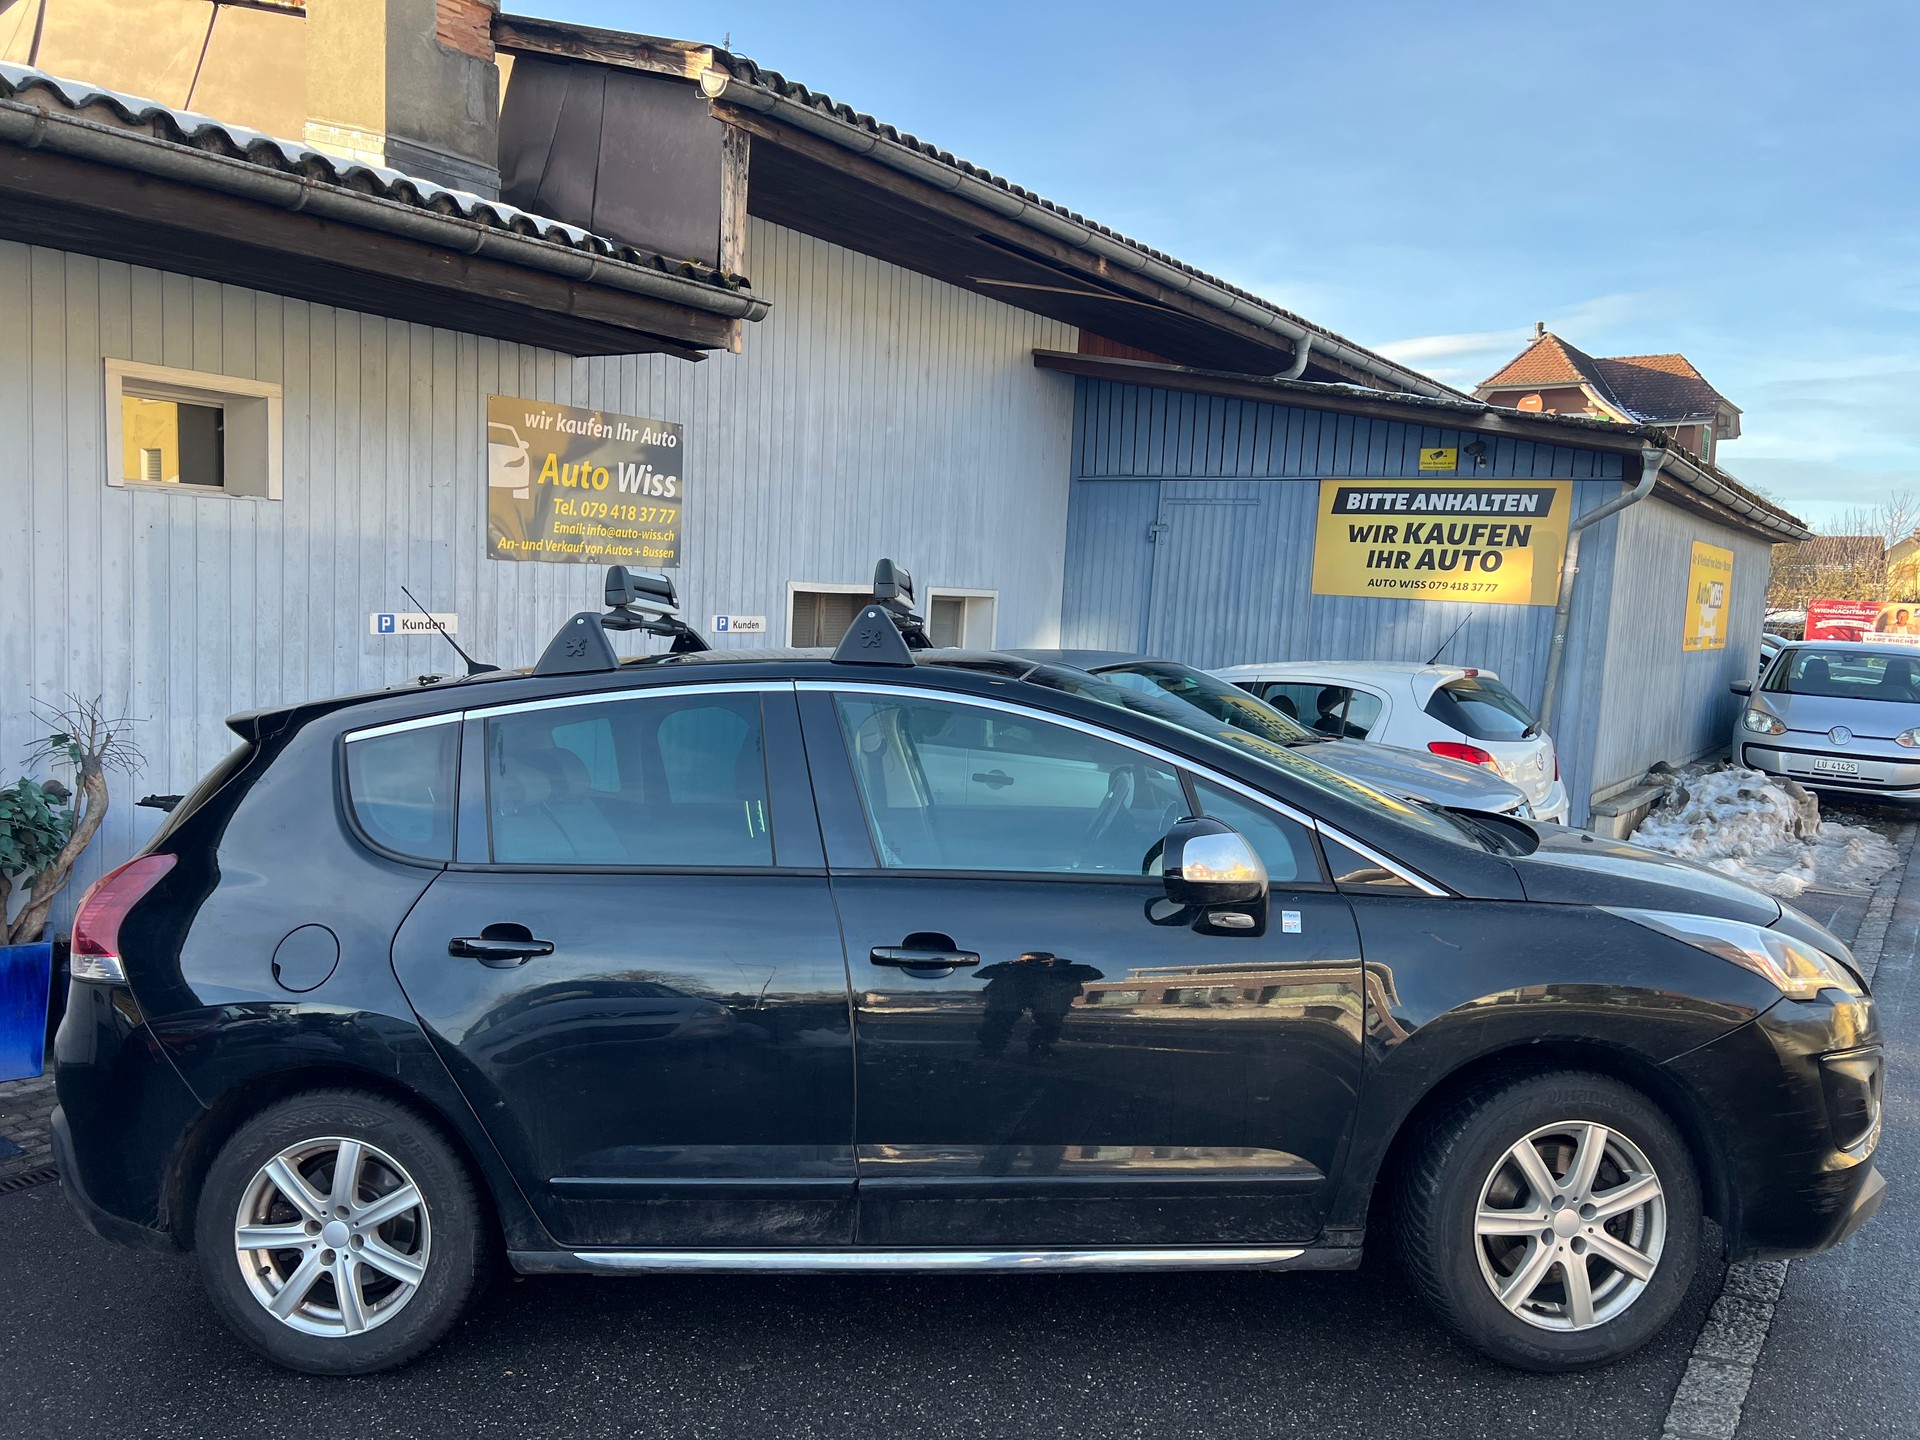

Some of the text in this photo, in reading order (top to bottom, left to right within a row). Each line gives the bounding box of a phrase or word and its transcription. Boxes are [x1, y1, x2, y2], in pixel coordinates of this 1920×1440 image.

[524, 411, 677, 448] wir kaufen Ihr Auto
[537, 452, 677, 498] Auto Wiss
[553, 498, 676, 524] Tel. 079 418 37 77
[1346, 492, 1539, 512] BITTE ANHALTEN
[553, 521, 675, 542] Email: info@auto-wiss.ch
[1348, 522, 1532, 547] WIR KAUFEN
[497, 536, 674, 559] An- und Verkauf von Autos + Bussen
[1366, 548, 1503, 573] IHR AUTO
[1367, 578, 1498, 593] AUTO WISS 079 418 37 77
[381, 616, 446, 631] P Kunden
[719, 618, 760, 630] P Kunden
[1817, 760, 1856, 771] LU 41425
